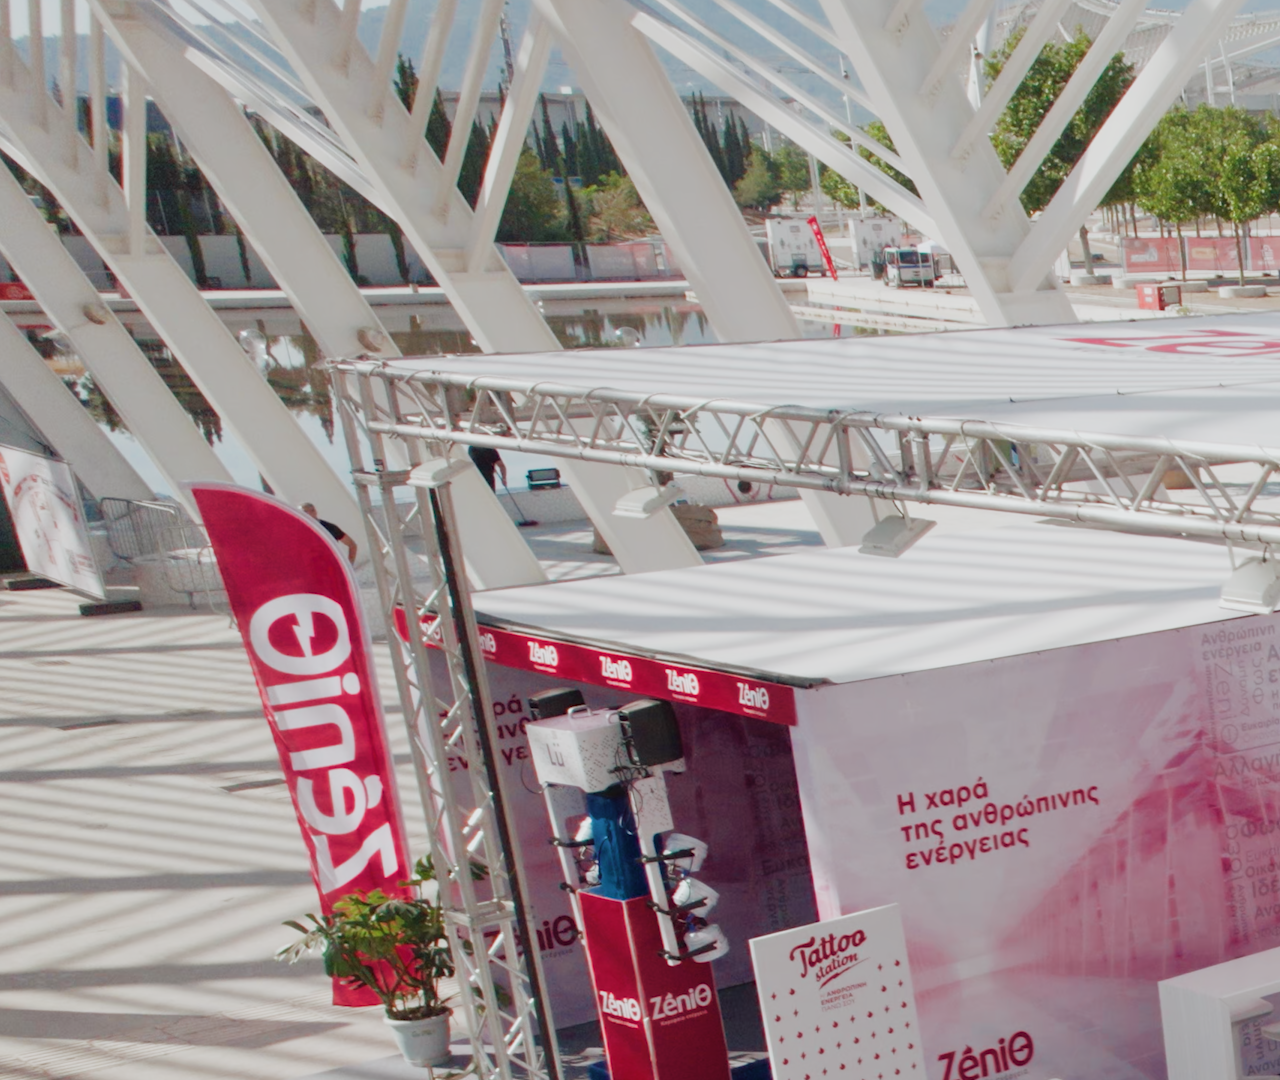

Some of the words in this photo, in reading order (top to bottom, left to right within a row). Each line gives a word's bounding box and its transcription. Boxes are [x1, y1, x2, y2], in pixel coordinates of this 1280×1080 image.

[1201, 624, 1275, 647] Ανθρώπινη
[1202, 641, 1262, 662] ενέργεια
[897, 792, 916, 815] Η
[924, 777, 989, 810] χαρά
[901, 819, 944, 842] της
[952, 786, 1100, 832] ανθρώπινης
[905, 828, 1030, 870] ενέργειας
[790, 929, 867, 978] Tattoo
[815, 953, 859, 982] station
